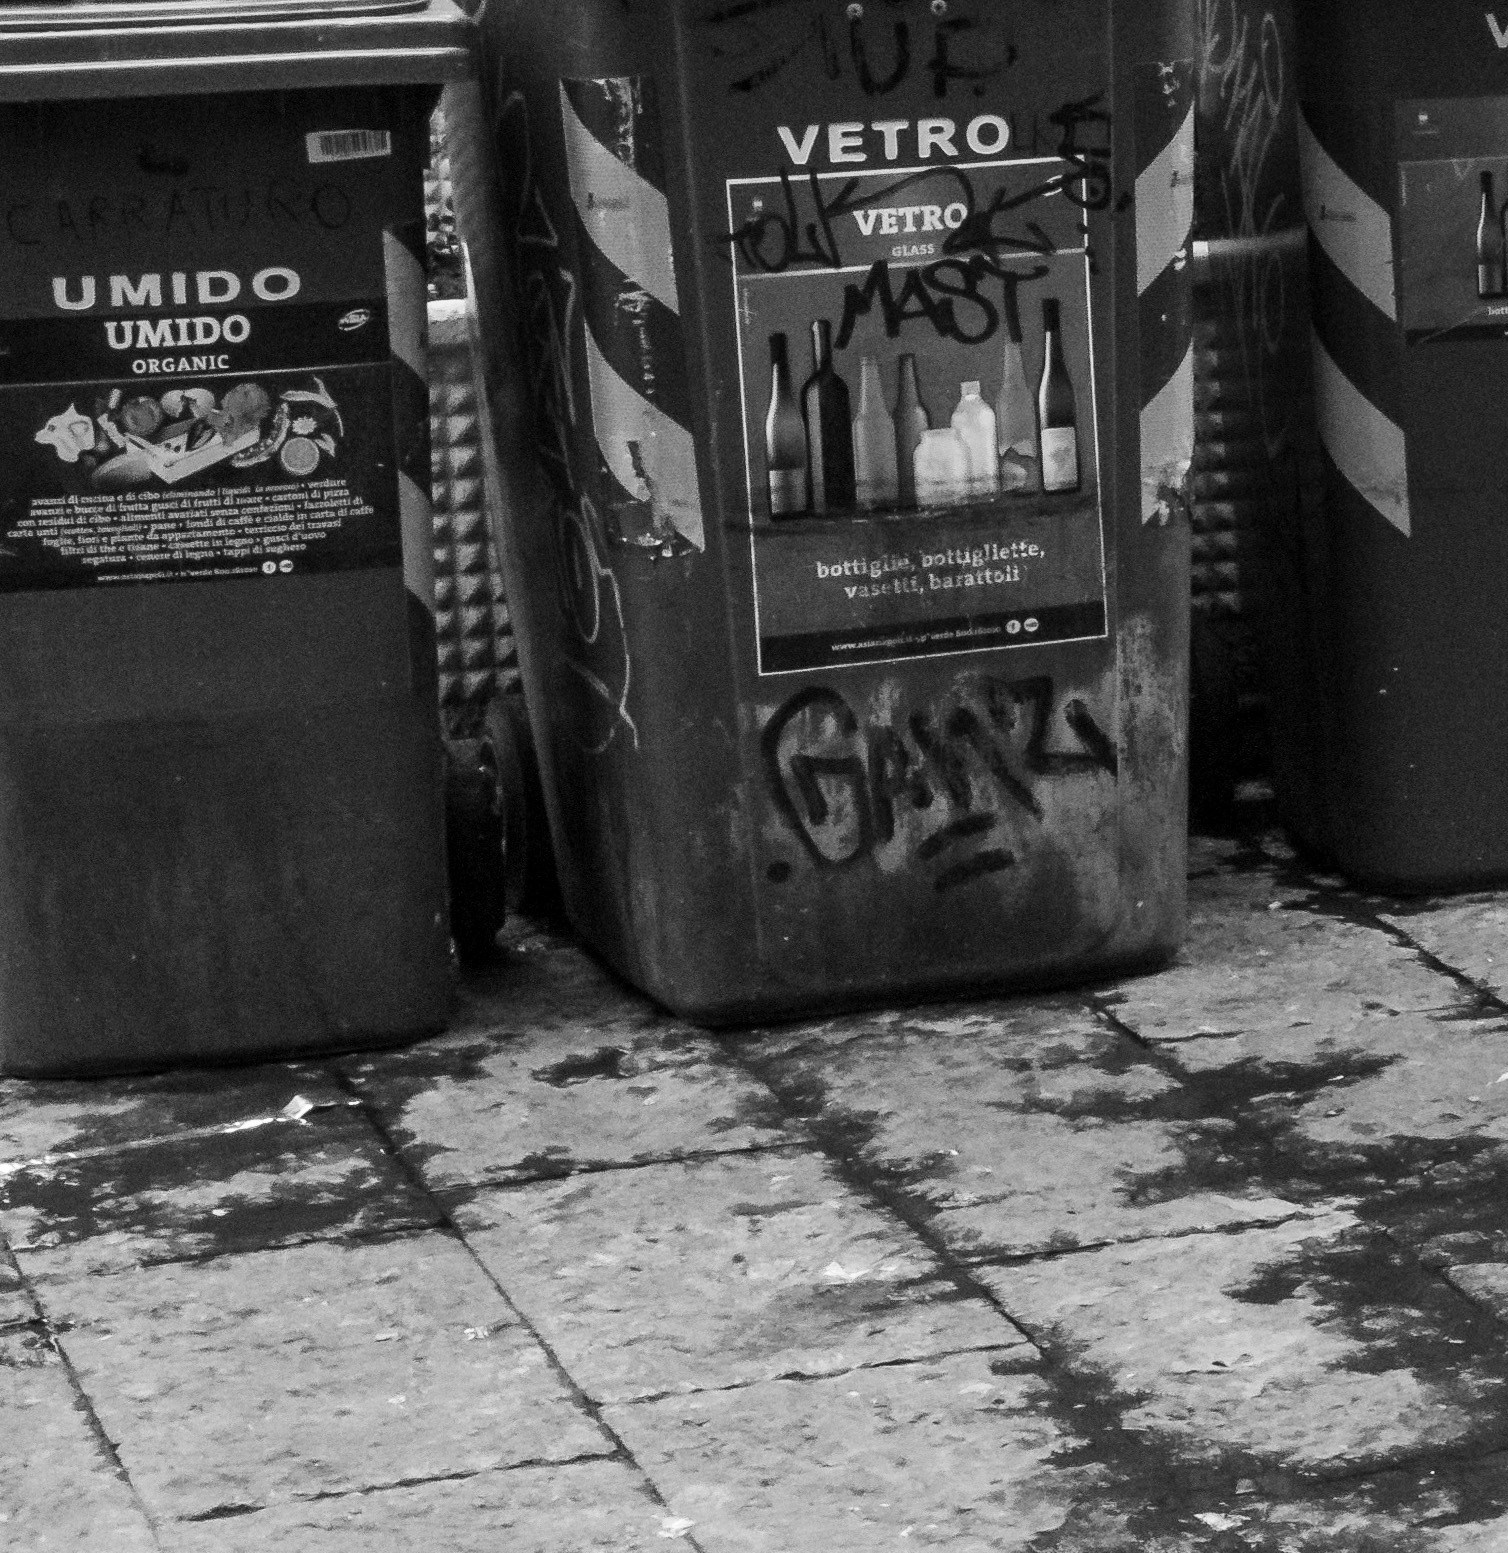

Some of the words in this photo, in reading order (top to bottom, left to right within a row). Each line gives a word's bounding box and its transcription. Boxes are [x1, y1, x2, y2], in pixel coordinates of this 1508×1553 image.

[776, 114, 1010, 165] VETRO
[852, 202, 968, 236] VETRO
[892, 243, 935, 258] GLASS
[52, 266, 301, 310] UMIDO
[104, 314, 251, 349] UMIDO
[132, 354, 230, 374] ORGANIC
[919, 540, 1045, 568] bottigliette,
[844, 576, 925, 599] vasetti,
[929, 564, 1020, 590] barattoli
